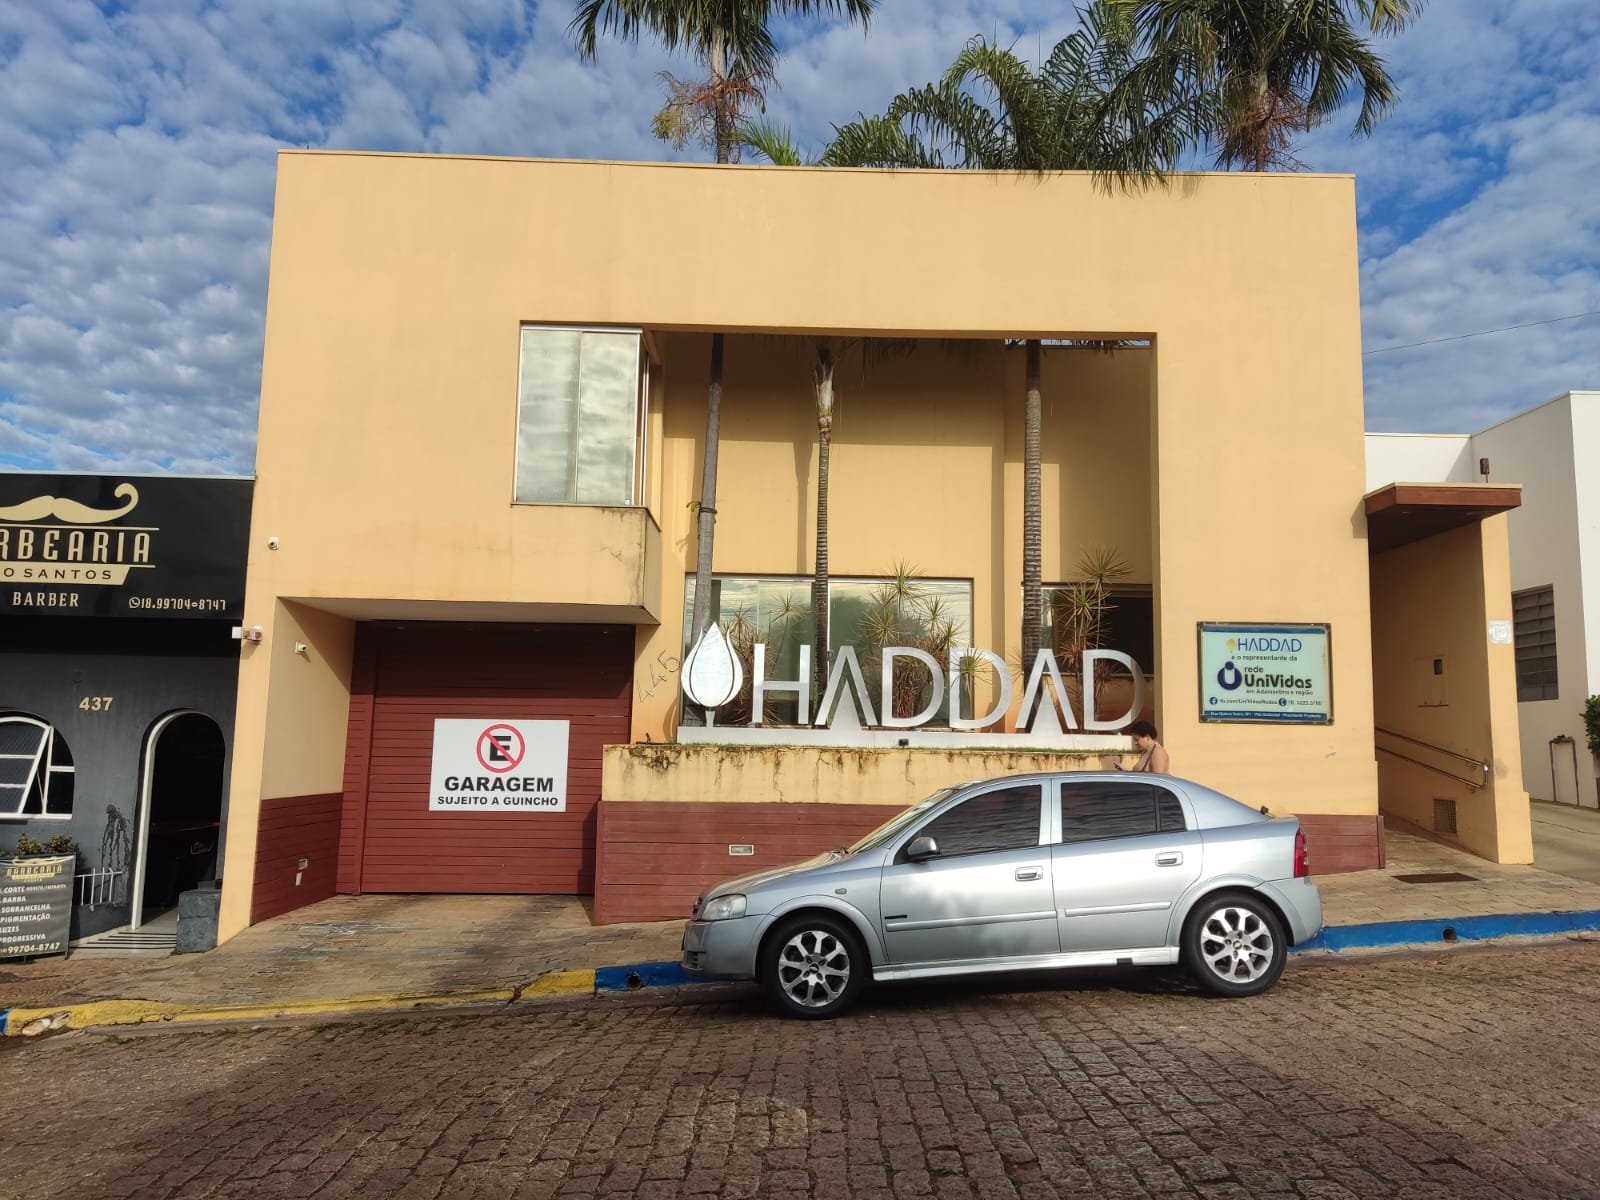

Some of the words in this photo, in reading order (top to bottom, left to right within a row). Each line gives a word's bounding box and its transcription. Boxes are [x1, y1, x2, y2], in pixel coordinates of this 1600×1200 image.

[23, 567, 112, 580] SANTOS
[12, 591, 80, 608] BARBER
[1237, 637, 1302, 653] HADDAD
[1244, 665, 1264, 673] rede
[1244, 673, 1313, 689] UniVidas
[752, 643, 1143, 732] HADDAD
[79, 696, 113, 711] 437
[444, 776, 554, 793] GARAGEM
[437, 796, 488, 805] SUJEITO
[491, 796, 500, 805] A
[503, 796, 558, 806] GUINCHO
[4, 886, 25, 894] CORTE
[2, 895, 26, 903] BARBA
[1, 903, 51, 914] SOBRANCELHA
[0, 912, 51, 923] PIGMENTAÇÃO
[8, 942, 60, 954] 99704-8747
